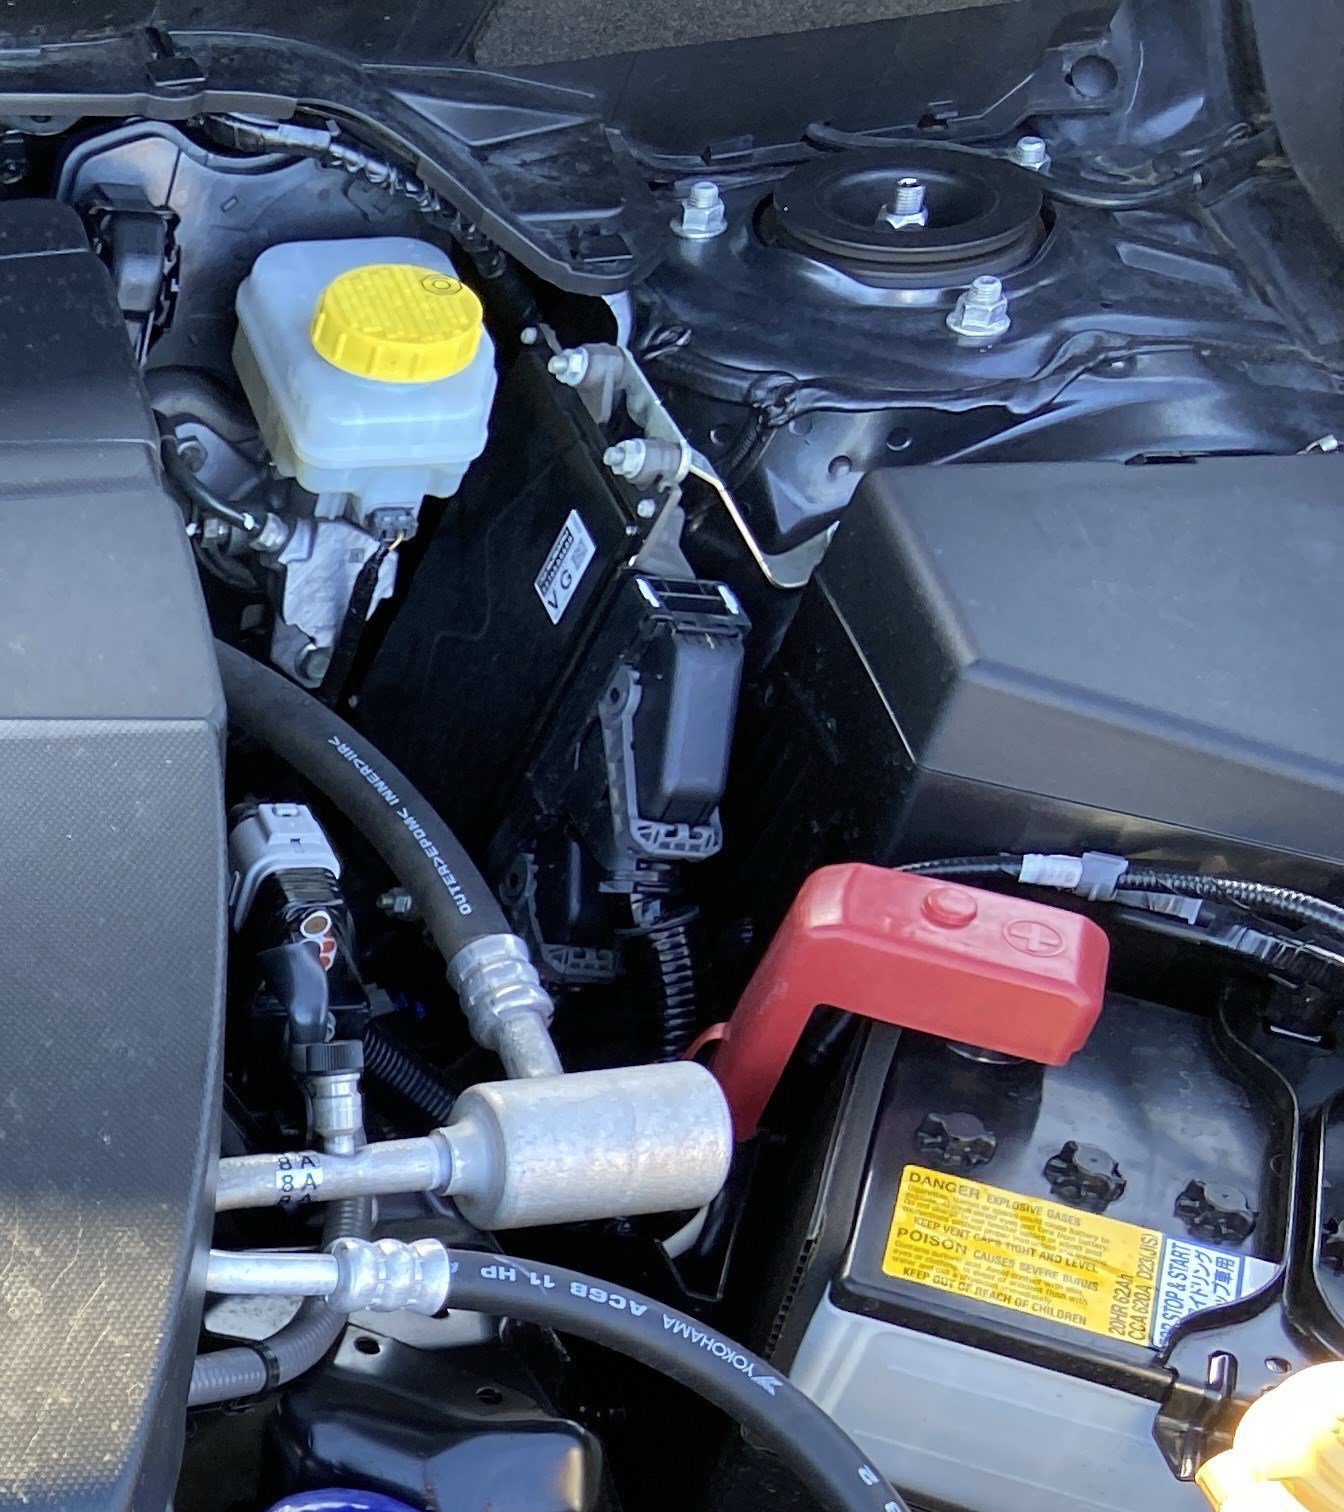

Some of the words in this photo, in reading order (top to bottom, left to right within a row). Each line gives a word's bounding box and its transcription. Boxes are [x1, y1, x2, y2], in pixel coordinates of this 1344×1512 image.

[281, 1174, 294, 1192] 8
[300, 1172, 317, 1190] A
[908, 1171, 981, 1201] DANGER
[986, 1193, 1044, 1217] EXPLOSIVE
[1046, 1209, 1082, 1226] GASES
[897, 1225, 968, 1256] POISON
[973, 1248, 1016, 1269] CAUSES
[1018, 1261, 1060, 1281] SEVERE
[1061, 1273, 1100, 1292] BURNS
[913, 1216, 941, 1231] KEEP
[942, 1224, 971, 1239] VENT
[1039, 1250, 1063, 1264] AND
[1065, 1256, 1100, 1274] LEVEL
[1136, 1233, 1158, 1281] D23(JIS)
[480, 1265, 516, 1281] HP
[1168, 1242, 1191, 1280] START
[529, 1272, 555, 1288] 11
[1114, 1273, 1133, 1304] 62Ah
[1167, 1281, 1186, 1292] &
[902, 1266, 930, 1282] KEEP
[932, 1274, 955, 1288] OUT
[957, 1281, 972, 1293] OF
[974, 1285, 1013, 1305] REACH
[1014, 1297, 1029, 1309] OF
[1031, 1301, 1088, 1326] CHILDREN
[1132, 1285, 1152, 1314] 620A
[1162, 1291, 1185, 1321] STOP
[1108, 1304, 1126, 1335] 20HR
[1128, 1315, 1148, 1341] CCA
[662, 1313, 755, 1377] YOKOHAMA
[857, 1464, 879, 1486] 2
